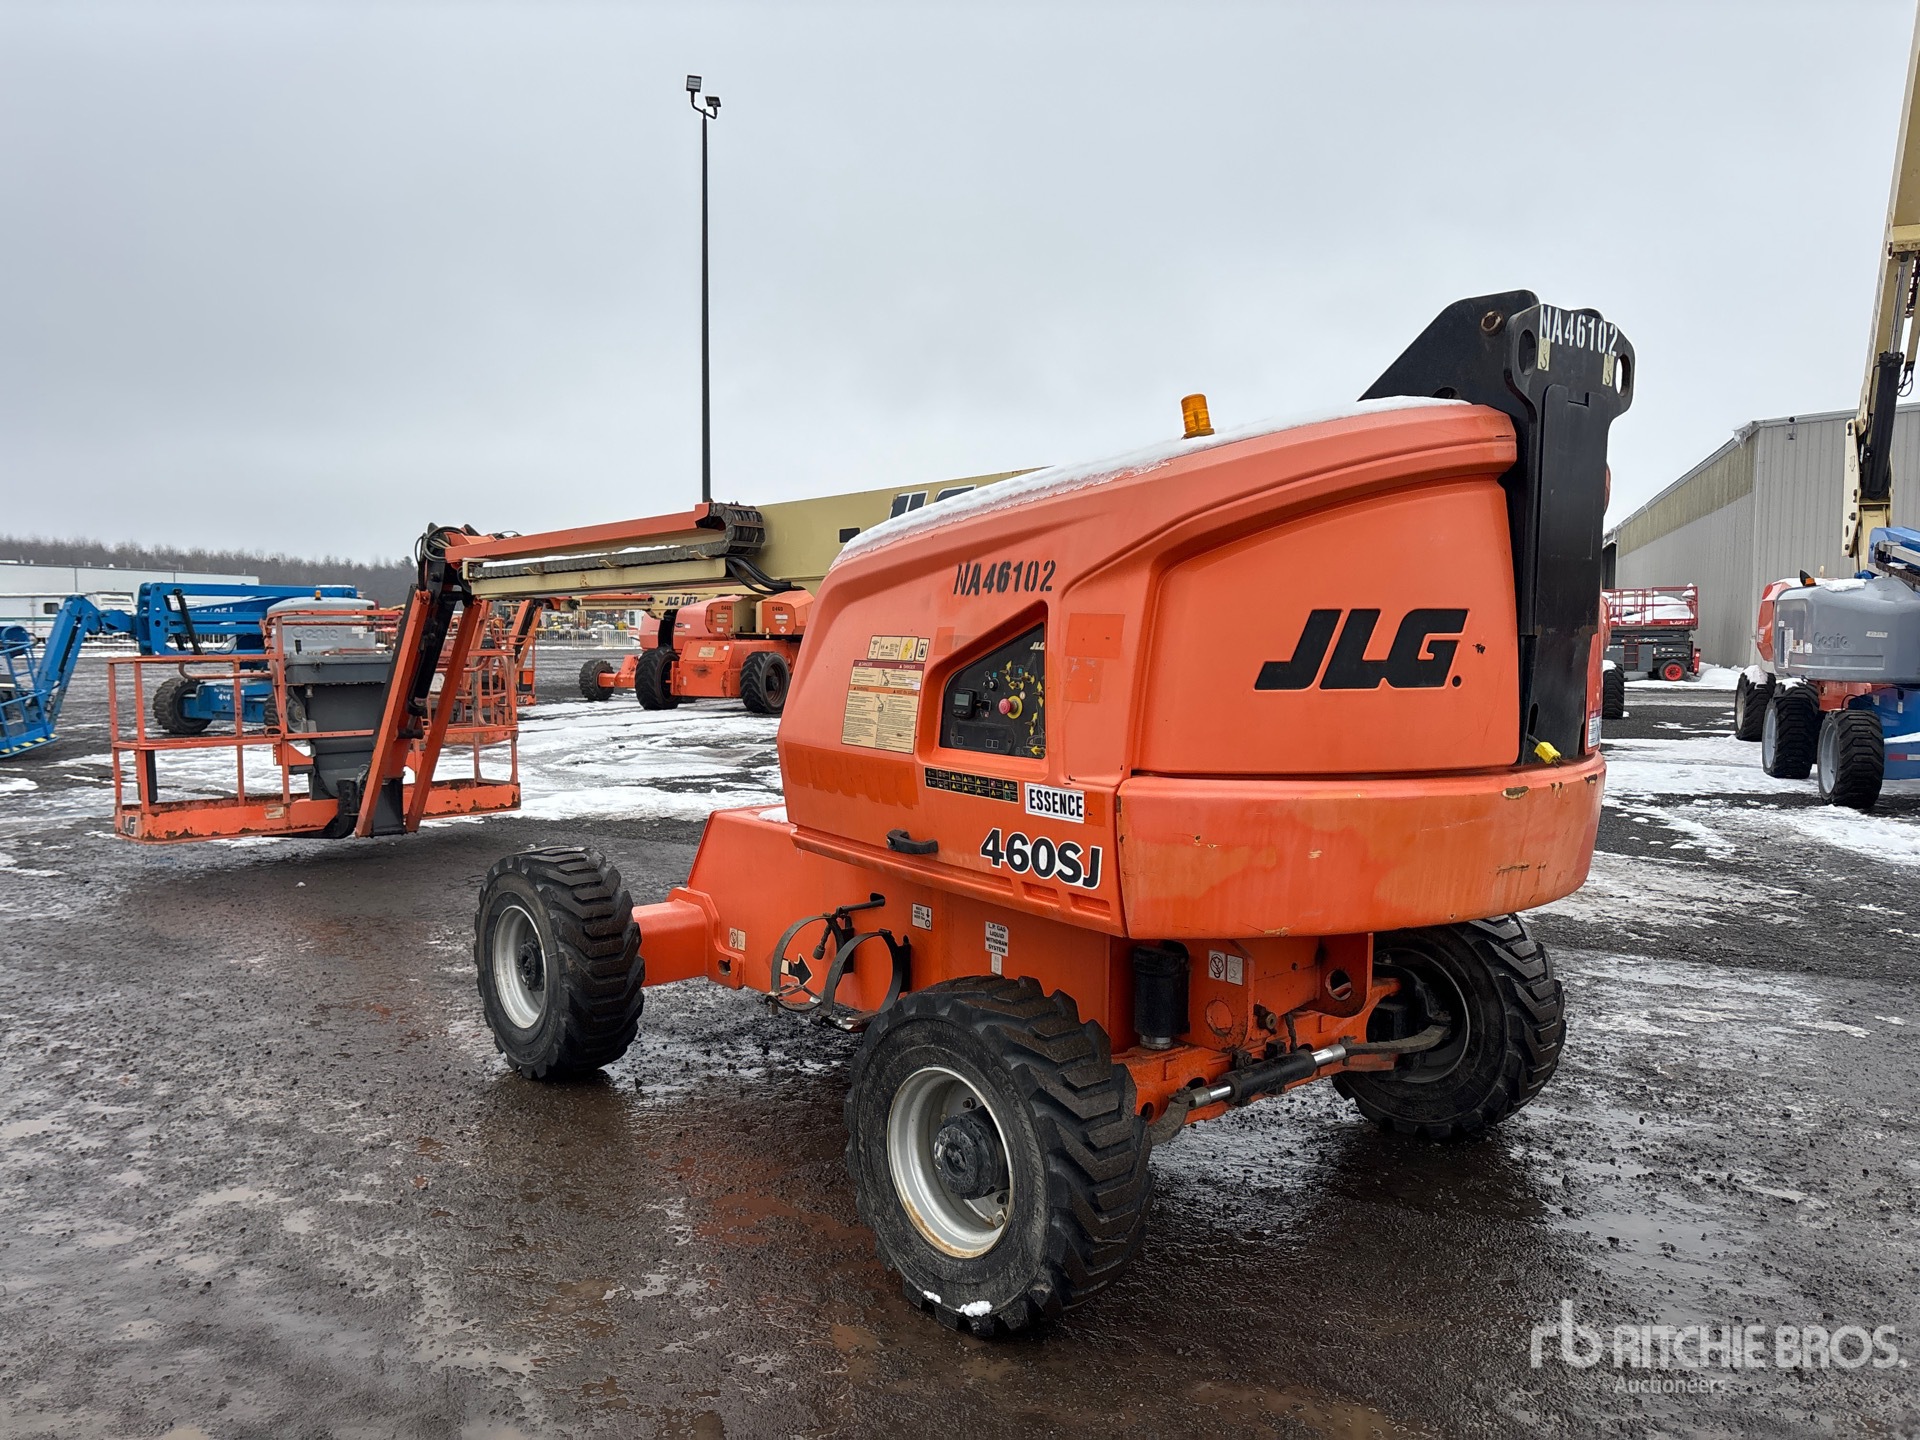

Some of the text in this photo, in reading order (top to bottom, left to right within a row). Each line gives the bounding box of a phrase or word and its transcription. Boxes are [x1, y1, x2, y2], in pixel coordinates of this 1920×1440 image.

[1539, 304, 1618, 357] NA46102
[953, 560, 1056, 596] NA46102
[665, 596, 680, 606] JLG
[1813, 631, 1850, 650] Genie
[1028, 788, 1084, 818] ESSENCE
[979, 827, 1103, 889] 460SJ
[990, 930, 1004, 938] LIQUID
[988, 944, 1006, 953] SYSTEM
